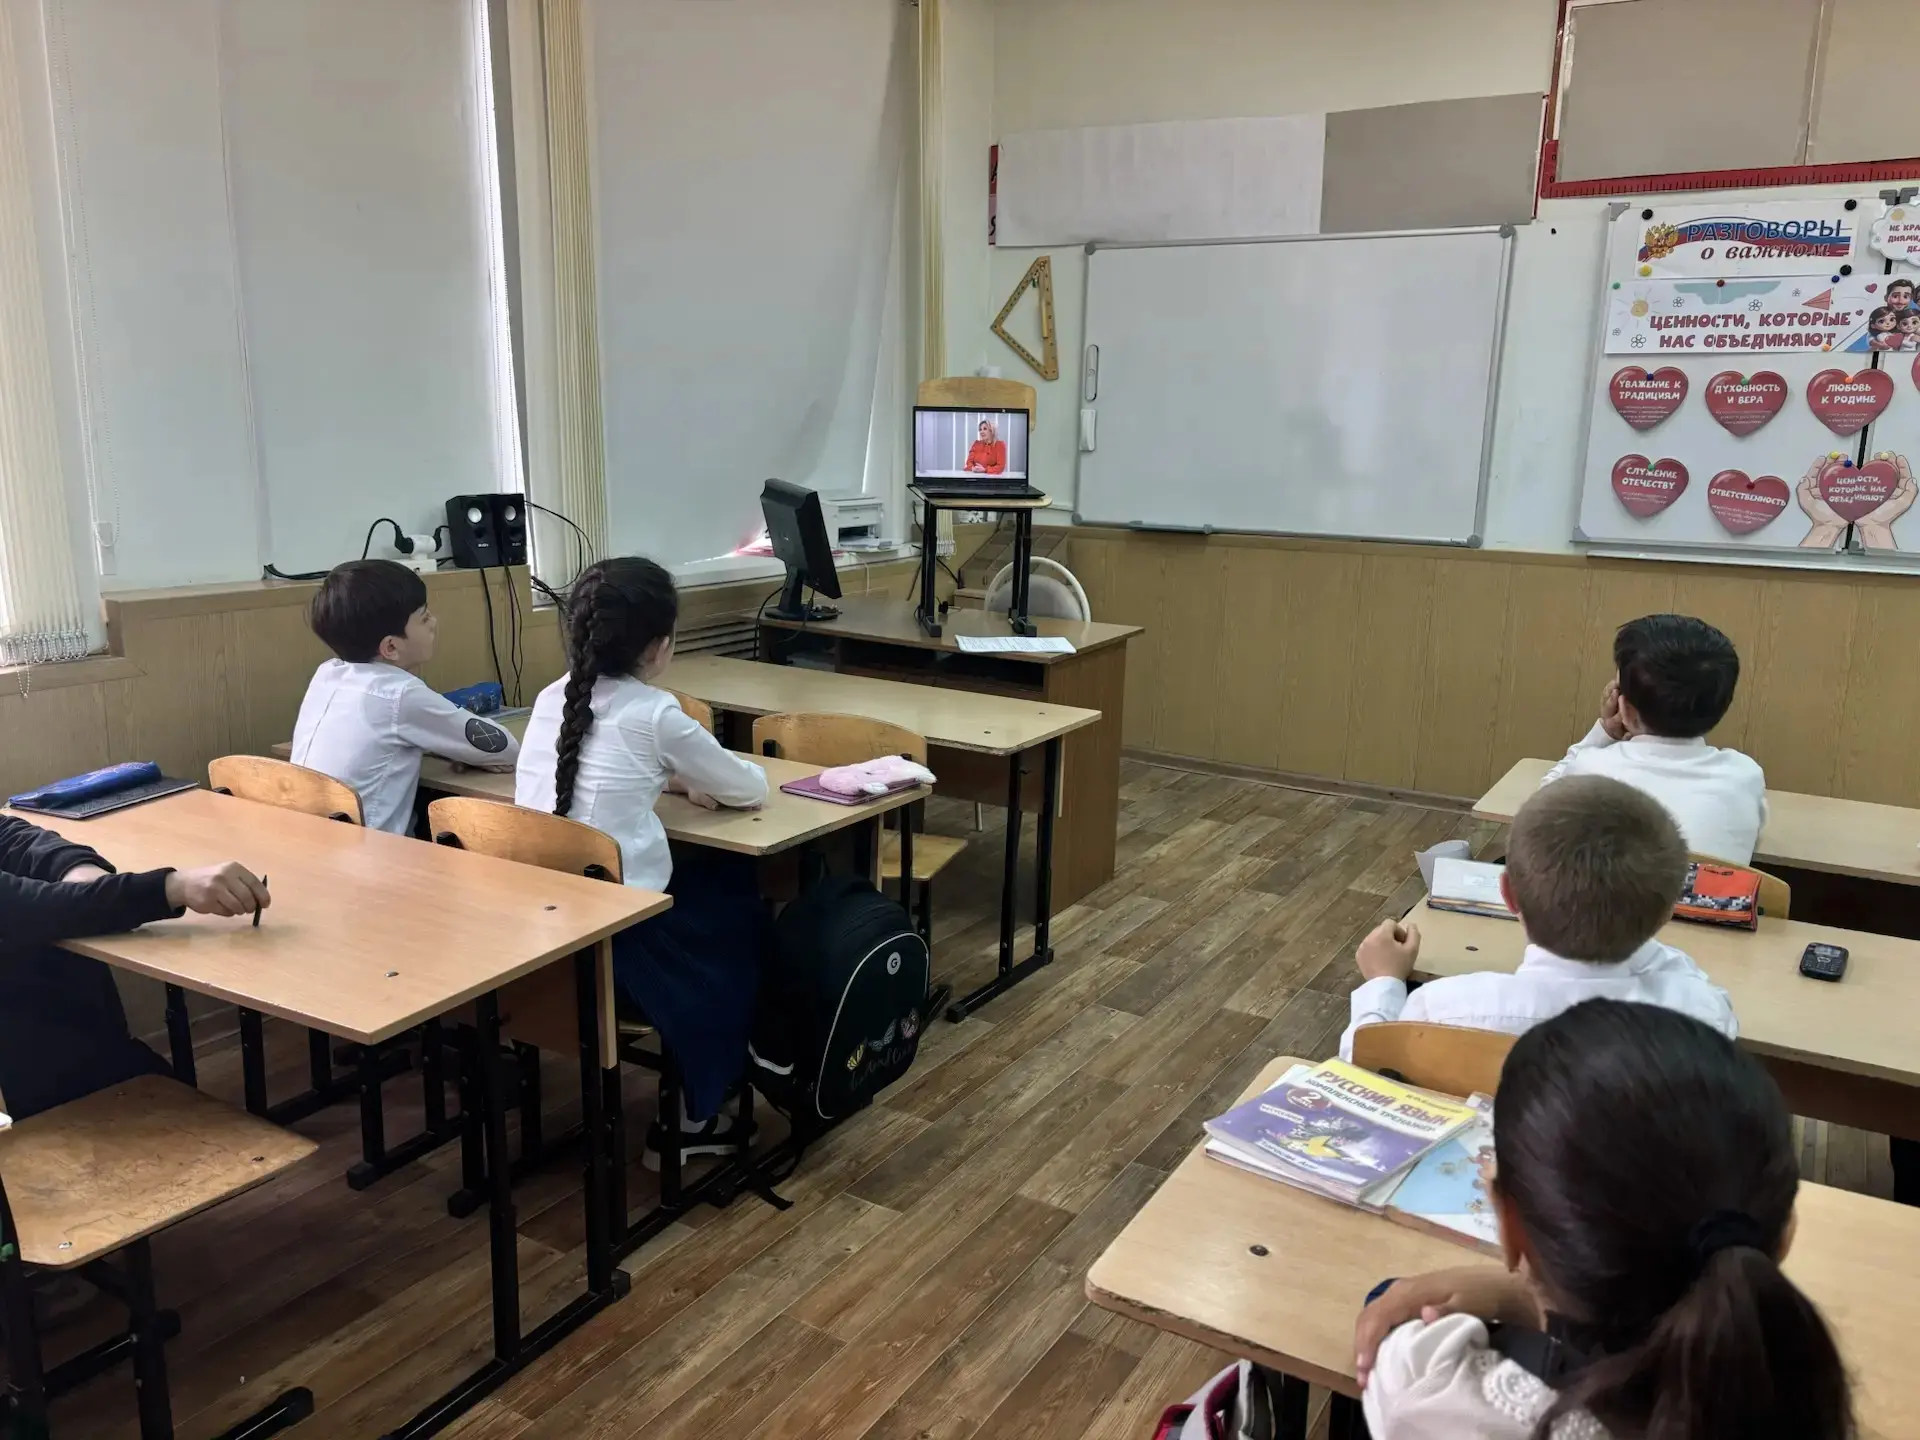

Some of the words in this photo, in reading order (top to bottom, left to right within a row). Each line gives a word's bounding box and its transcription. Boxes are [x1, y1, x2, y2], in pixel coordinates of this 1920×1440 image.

[1686, 219, 1842, 242] РАЗГОВОРЫ
[1889, 224, 1900, 232] НЕ
[1700, 246, 1714, 260] о
[1725, 243, 1831, 260] важном
[1649, 313, 1751, 331] ЦЕННОСТИ,
[1758, 311, 1851, 327] КОТОРЫЕ
[1659, 334, 1695, 348] НАС
[1703, 332, 1837, 350] ОБЪЕДИНЯЮТ
[1619, 379, 1670, 389] УВАЖЕНИЕ
[1673, 380, 1682, 389] К
[1714, 384, 1781, 394] ДУХОВНОСТЬ
[1825, 383, 1872, 393] ЛЮБОВЬ
[1618, 391, 1681, 401] ТРАДИЦИЯМ
[1726, 396, 1734, 404] И
[1737, 395, 1764, 404] ВЕРА
[1821, 395, 1829, 404] К
[1833, 395, 1877, 405] РОДИНЕ
[1626, 467, 1678, 479] СЛУЖЕНИЕ
[1621, 477, 1676, 490] ОТЕЧЕСТВУ
[1710, 488, 1787, 507] ОТВЕТСТВЕННОСТЬ
[1301, 1091, 1322, 1104] 2
[1305, 1078, 1379, 1112] КОМПЛЕКСНЫЙ
[1316, 1070, 1398, 1107] РУССКИЙ
[1394, 1103, 1453, 1126] ЯЗЫК
